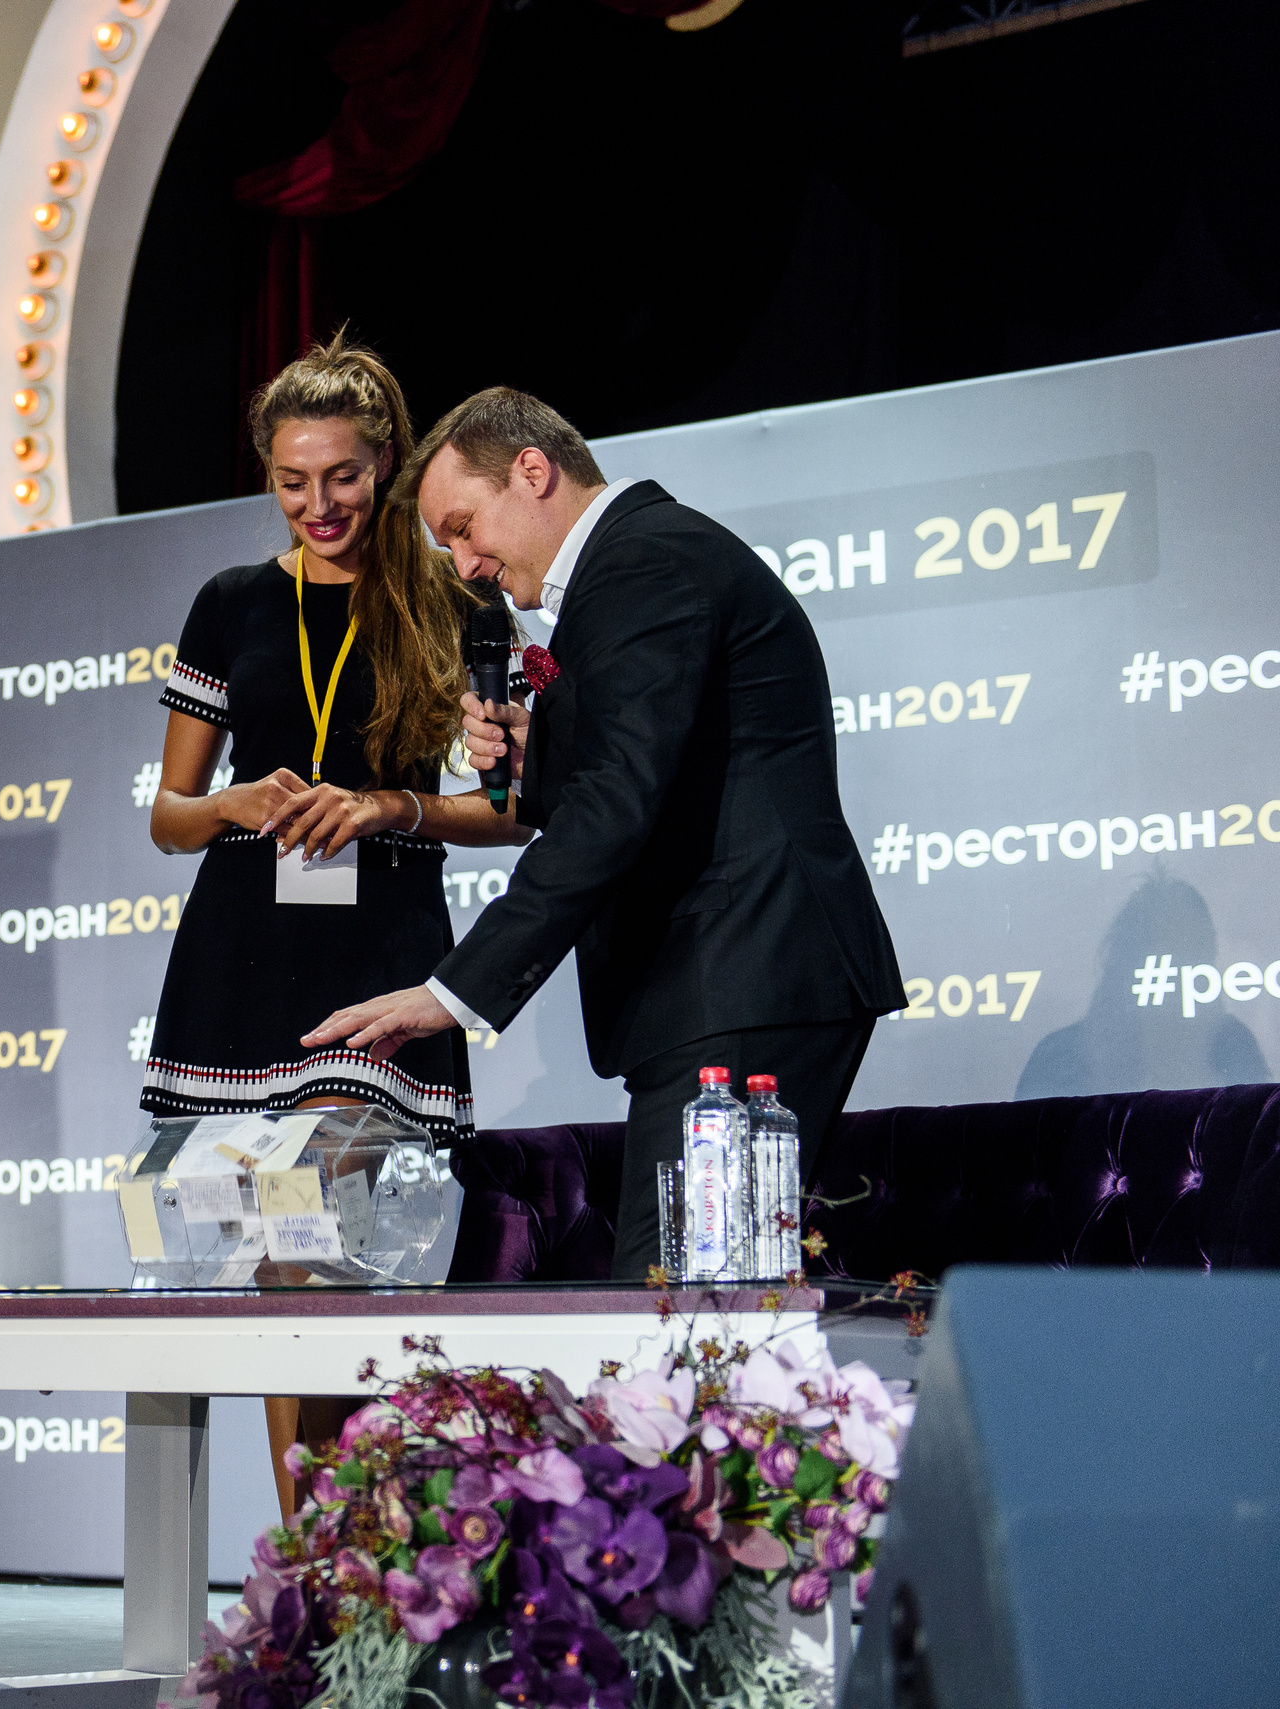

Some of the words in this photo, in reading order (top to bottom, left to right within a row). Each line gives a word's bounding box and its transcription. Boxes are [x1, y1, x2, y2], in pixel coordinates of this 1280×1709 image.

[914, 491, 1127, 579] 2017
[888, 970, 1042, 1022] 2017
[704, 1159, 714, 1231] KORSTON
